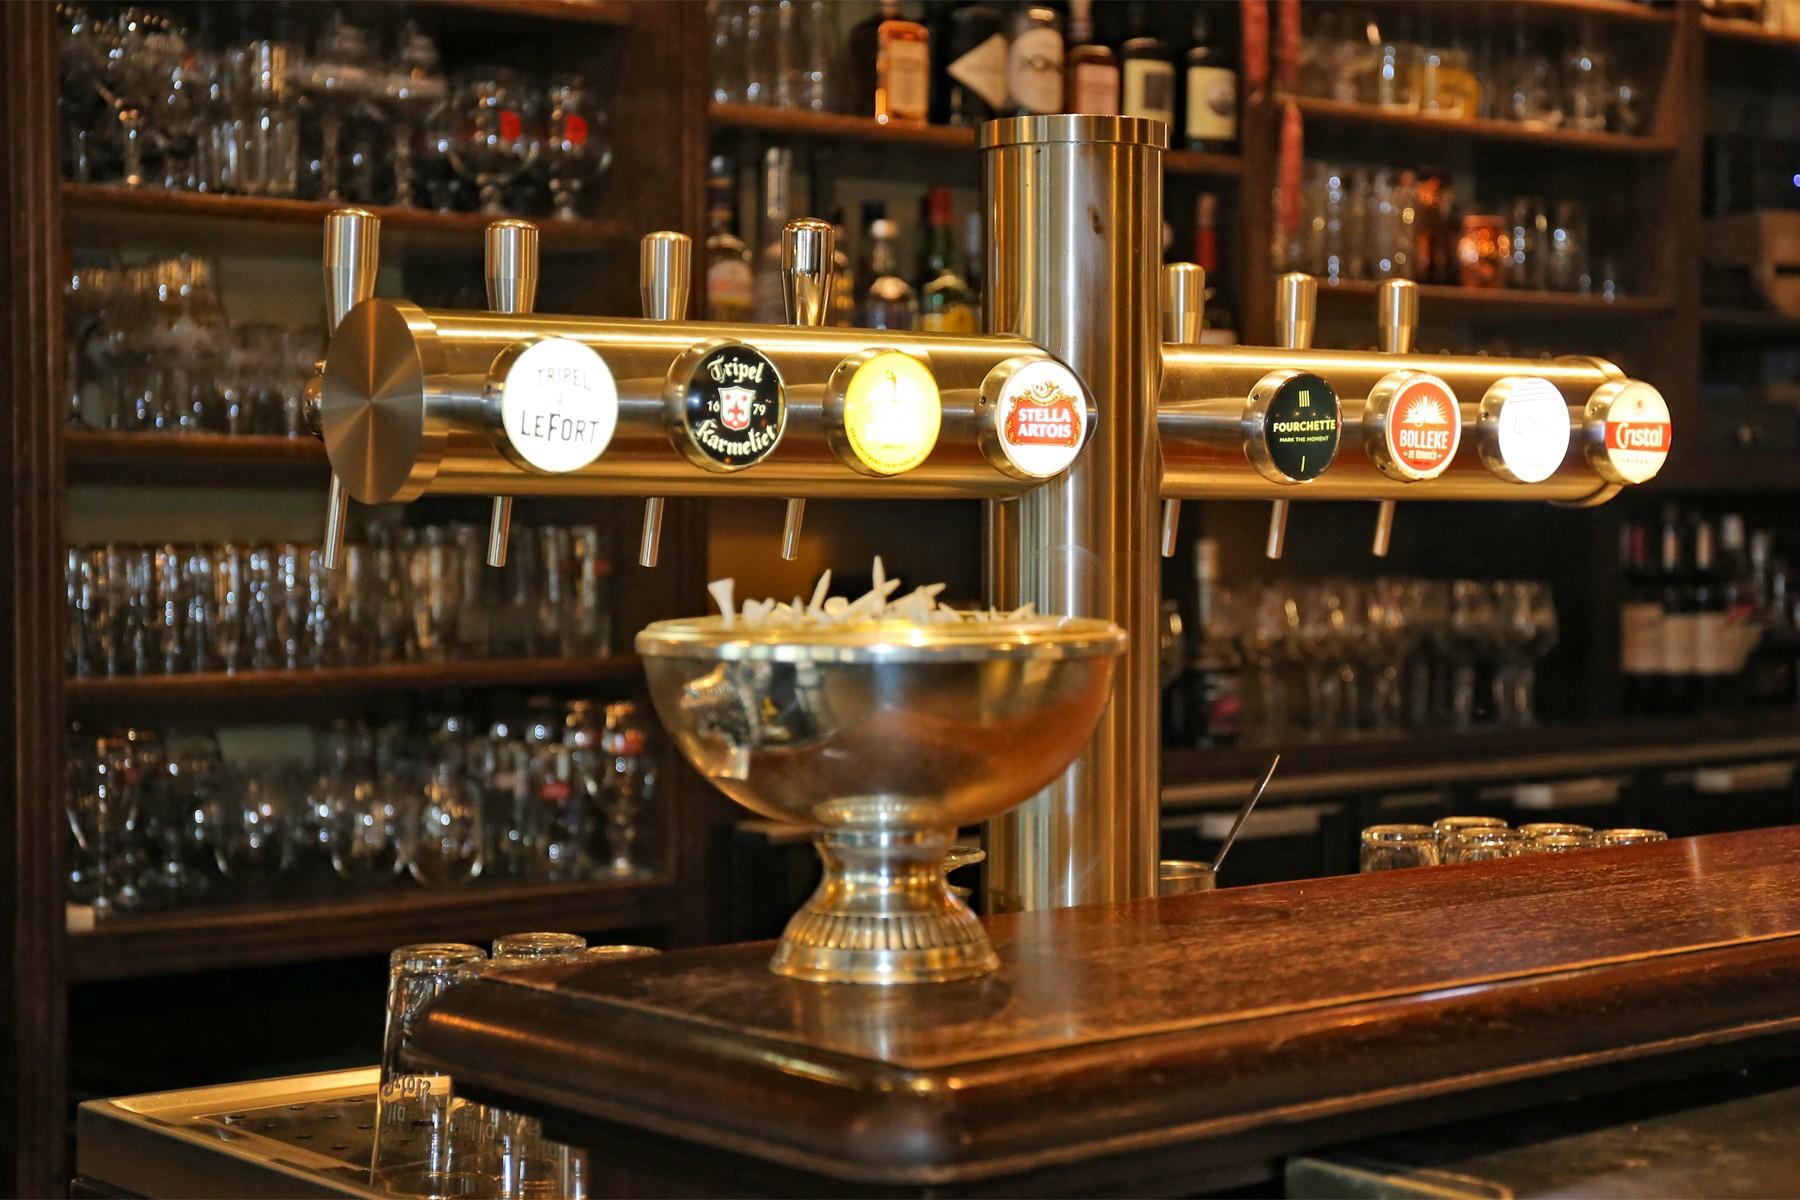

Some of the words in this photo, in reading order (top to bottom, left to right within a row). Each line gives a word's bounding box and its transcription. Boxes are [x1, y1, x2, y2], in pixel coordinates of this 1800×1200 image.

[537, 367, 593, 391] TRIPEL
[707, 355, 764, 383] Tripel
[707, 400, 720, 412] 16
[753, 403, 766, 416] 79
[1018, 408, 1071, 422] STELLA
[1018, 423, 1071, 438] ARTOIS
[1273, 419, 1336, 432] FOURCHETTE
[1616, 422, 1663, 449] Cristal
[696, 418, 777, 456] Karmeliet
[1400, 429, 1449, 449] BOLLEKE
